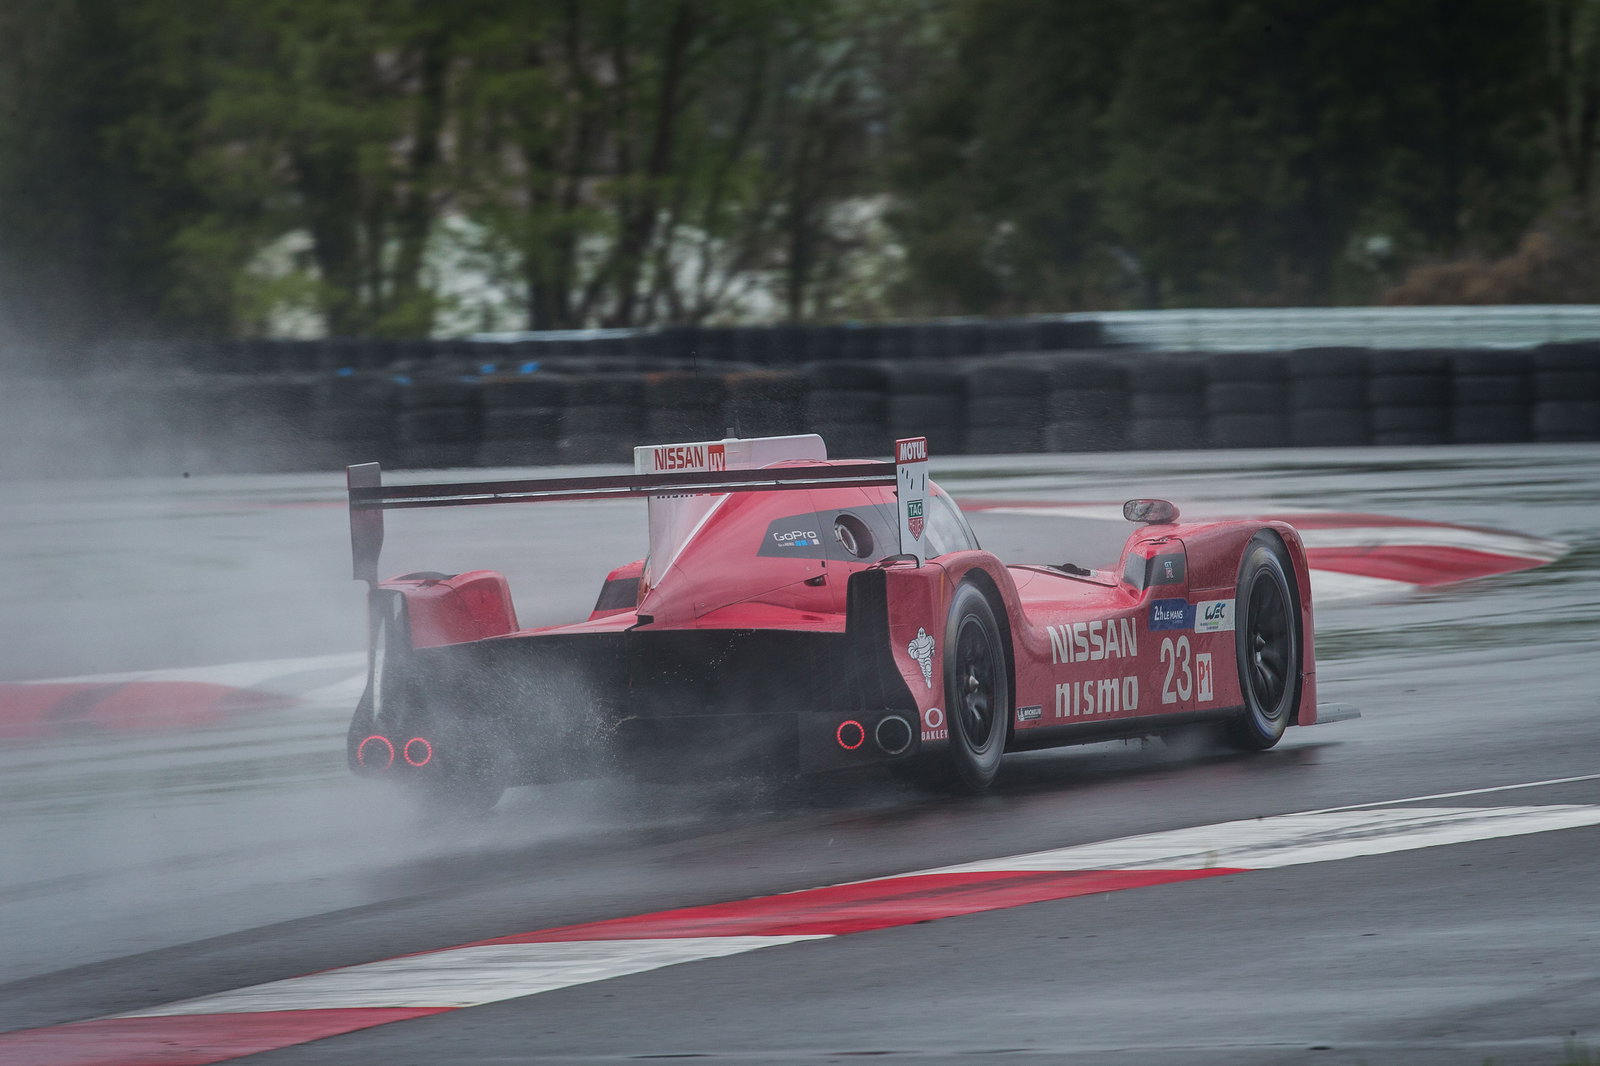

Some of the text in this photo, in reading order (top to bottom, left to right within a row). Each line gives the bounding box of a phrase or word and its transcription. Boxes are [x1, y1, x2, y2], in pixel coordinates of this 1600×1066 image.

[655, 446, 703, 470] NISSAN
[900, 441, 926, 460] MOTUL
[908, 503, 922, 516] TAG
[773, 530, 817, 541] GoPro
[1205, 603, 1226, 620] WEC
[1046, 617, 1138, 665] NISSAN
[1160, 635, 1193, 704] 23
[1197, 660, 1213, 696] P1
[921, 730, 948, 741] OAKLEY
